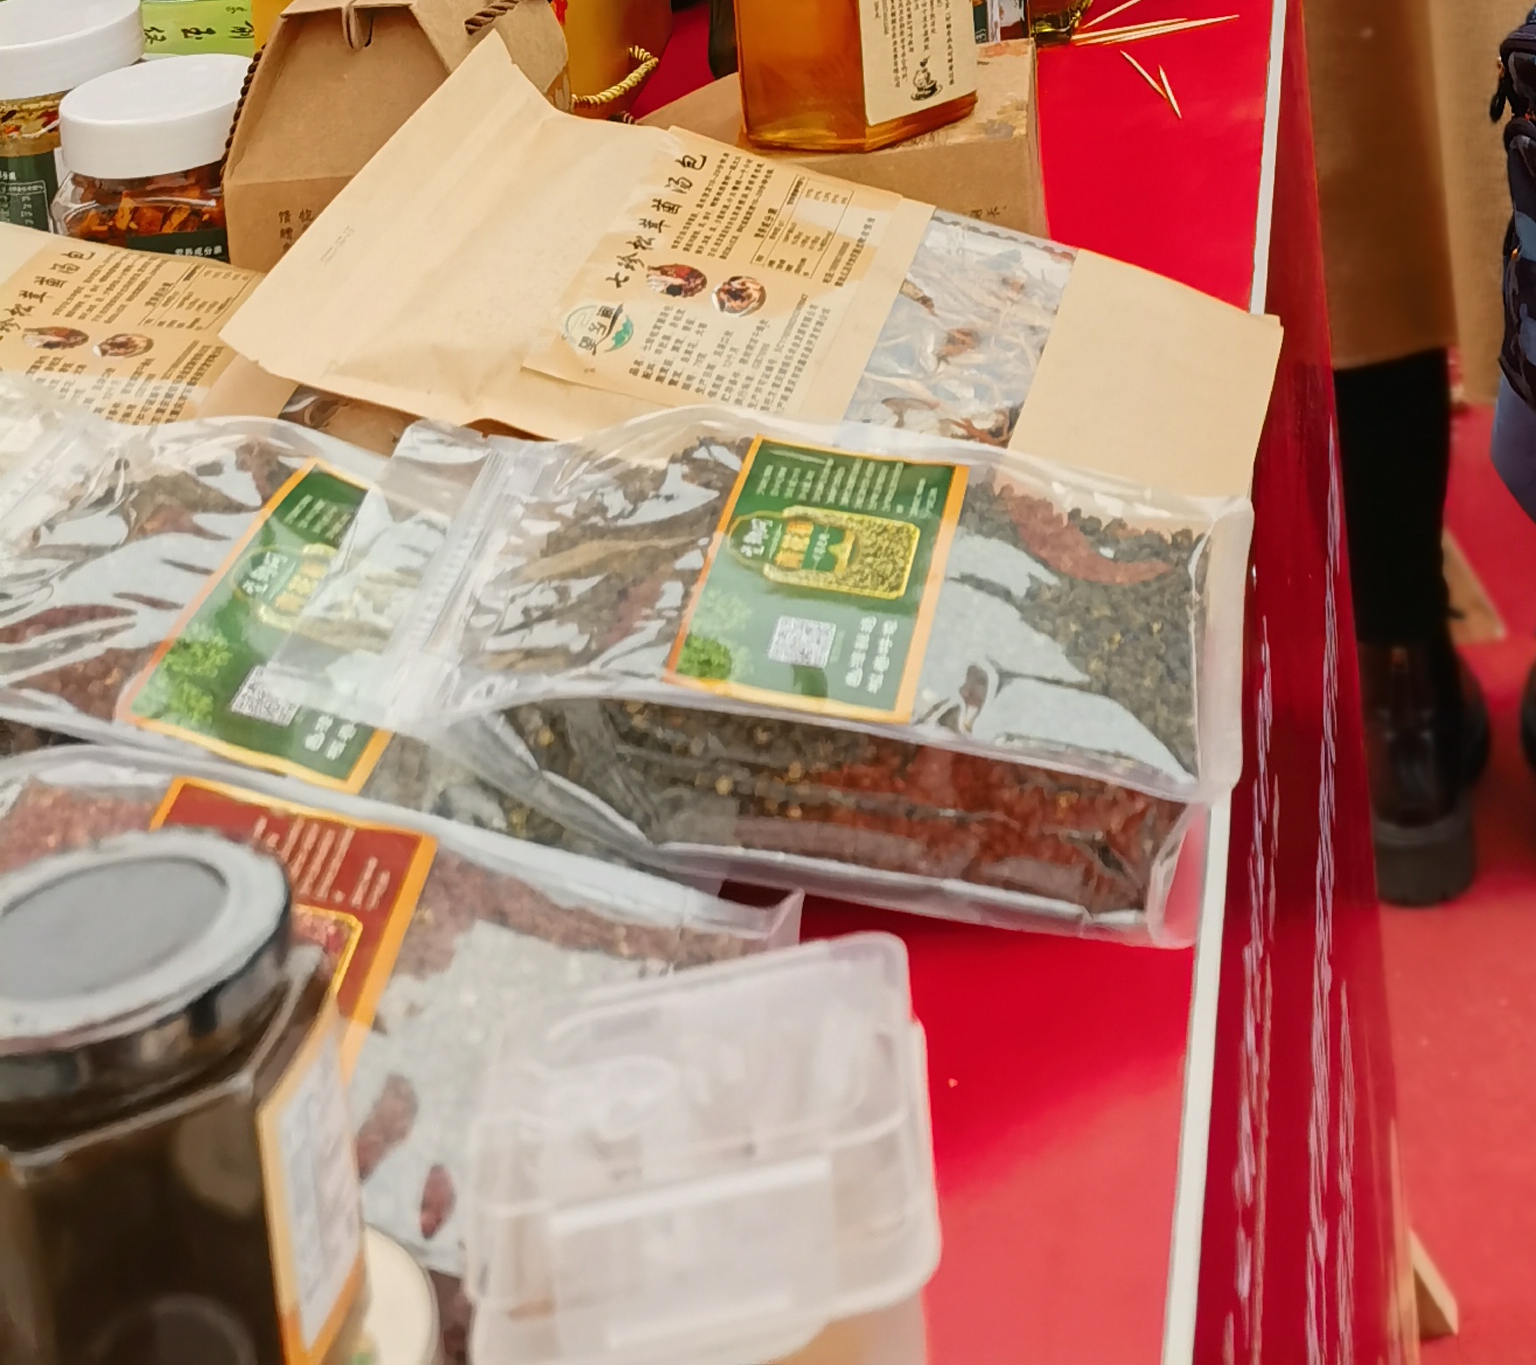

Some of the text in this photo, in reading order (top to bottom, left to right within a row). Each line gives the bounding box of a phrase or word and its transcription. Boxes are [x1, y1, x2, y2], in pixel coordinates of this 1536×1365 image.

[604, 153, 708, 289] 七珍松茸菌汤包
[0, 249, 96, 339] 珍松茸菌汤包
